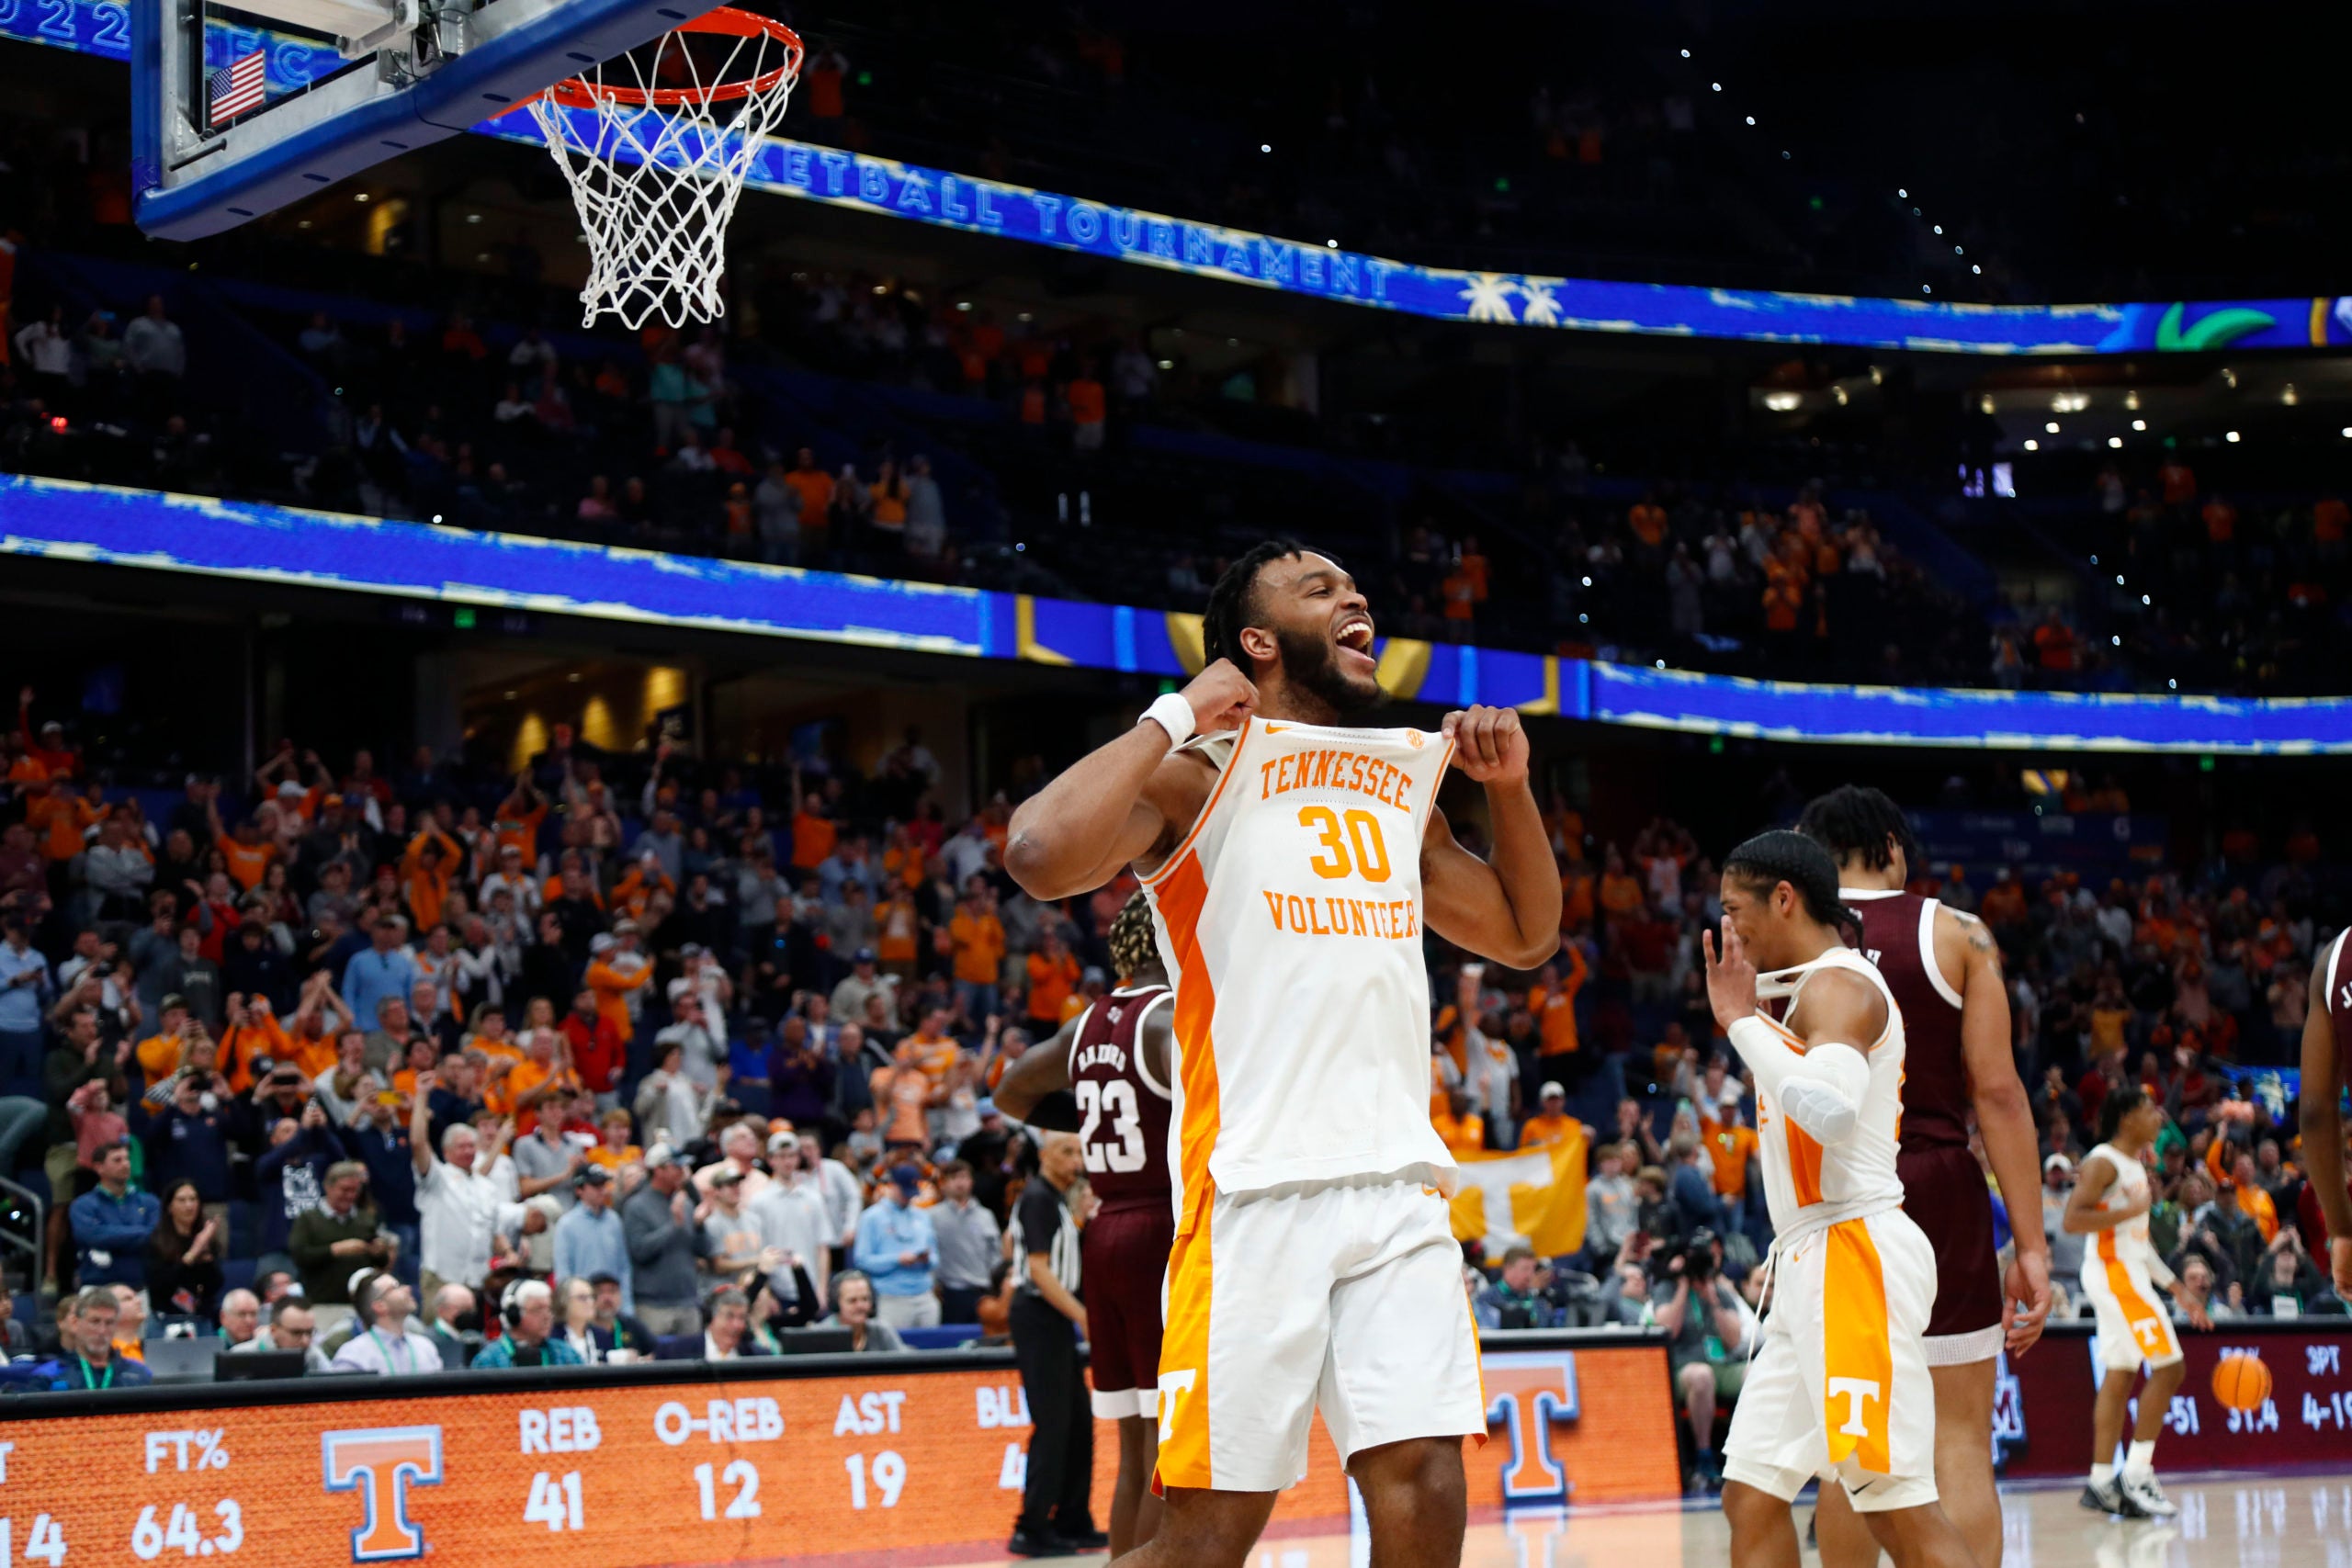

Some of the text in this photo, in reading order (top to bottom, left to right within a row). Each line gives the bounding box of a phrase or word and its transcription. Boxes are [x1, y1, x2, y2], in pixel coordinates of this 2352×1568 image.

[1033, 194, 1391, 298] TOURNAMENT
[1261, 750, 1413, 814] TENNESSEE
[1297, 806, 1392, 883] 30
[1262, 890, 1419, 940] VOLUNTEER
[1075, 1079, 1147, 1173] 23
[519, 1406, 603, 1454] REB
[653, 1396, 785, 1447] O-REB
[832, 1390, 907, 1437] AST
[1828, 1376, 1881, 1438] T
[145, 1428, 231, 1474] FT%
[844, 1450, 908, 1510] 19
[523, 1470, 584, 1533] 41
[693, 1459, 763, 1521] 12
[130, 1498, 244, 1561] 64.3
